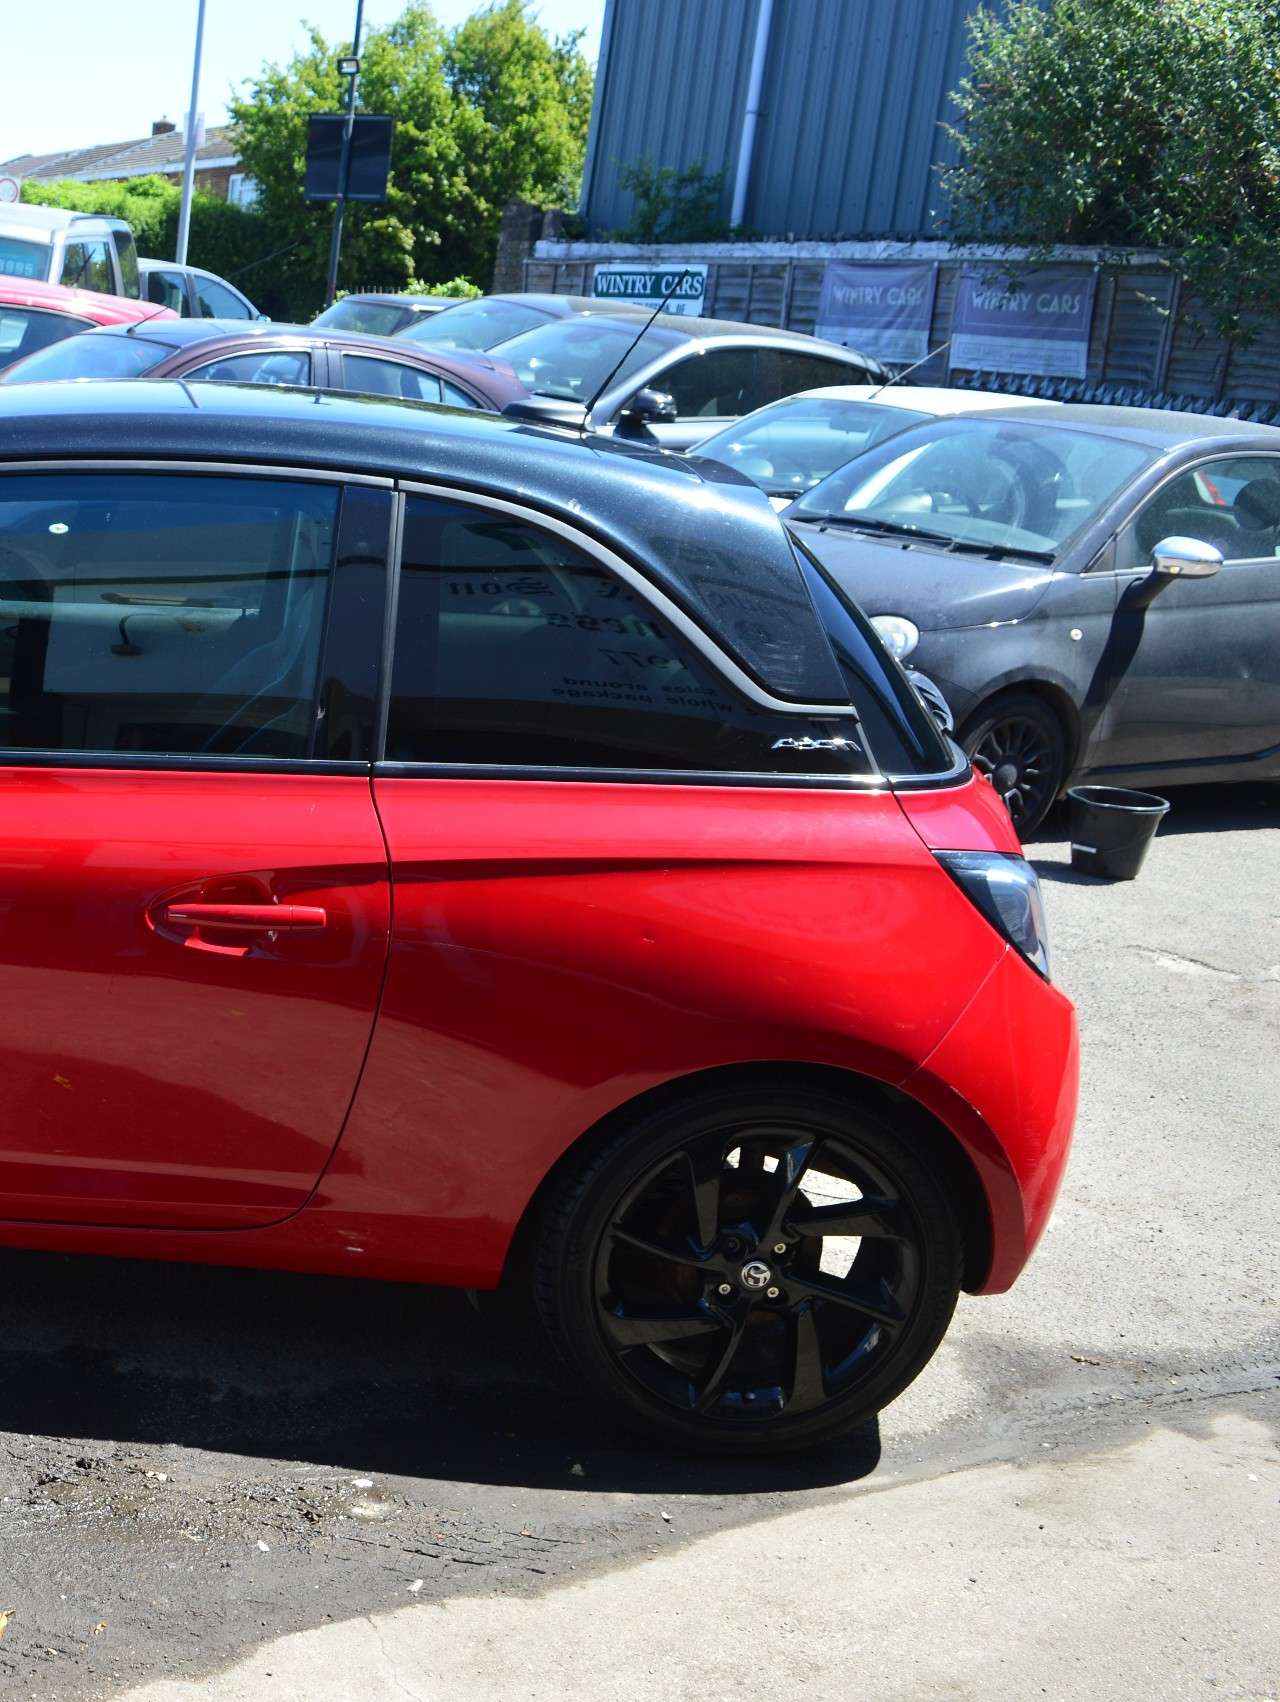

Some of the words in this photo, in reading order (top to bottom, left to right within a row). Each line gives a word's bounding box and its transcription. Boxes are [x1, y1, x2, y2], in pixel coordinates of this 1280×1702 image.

[597, 274, 656, 294] WINTRY
[661, 275, 703, 296] CARS
[1036, 293, 1081, 315] CARS
